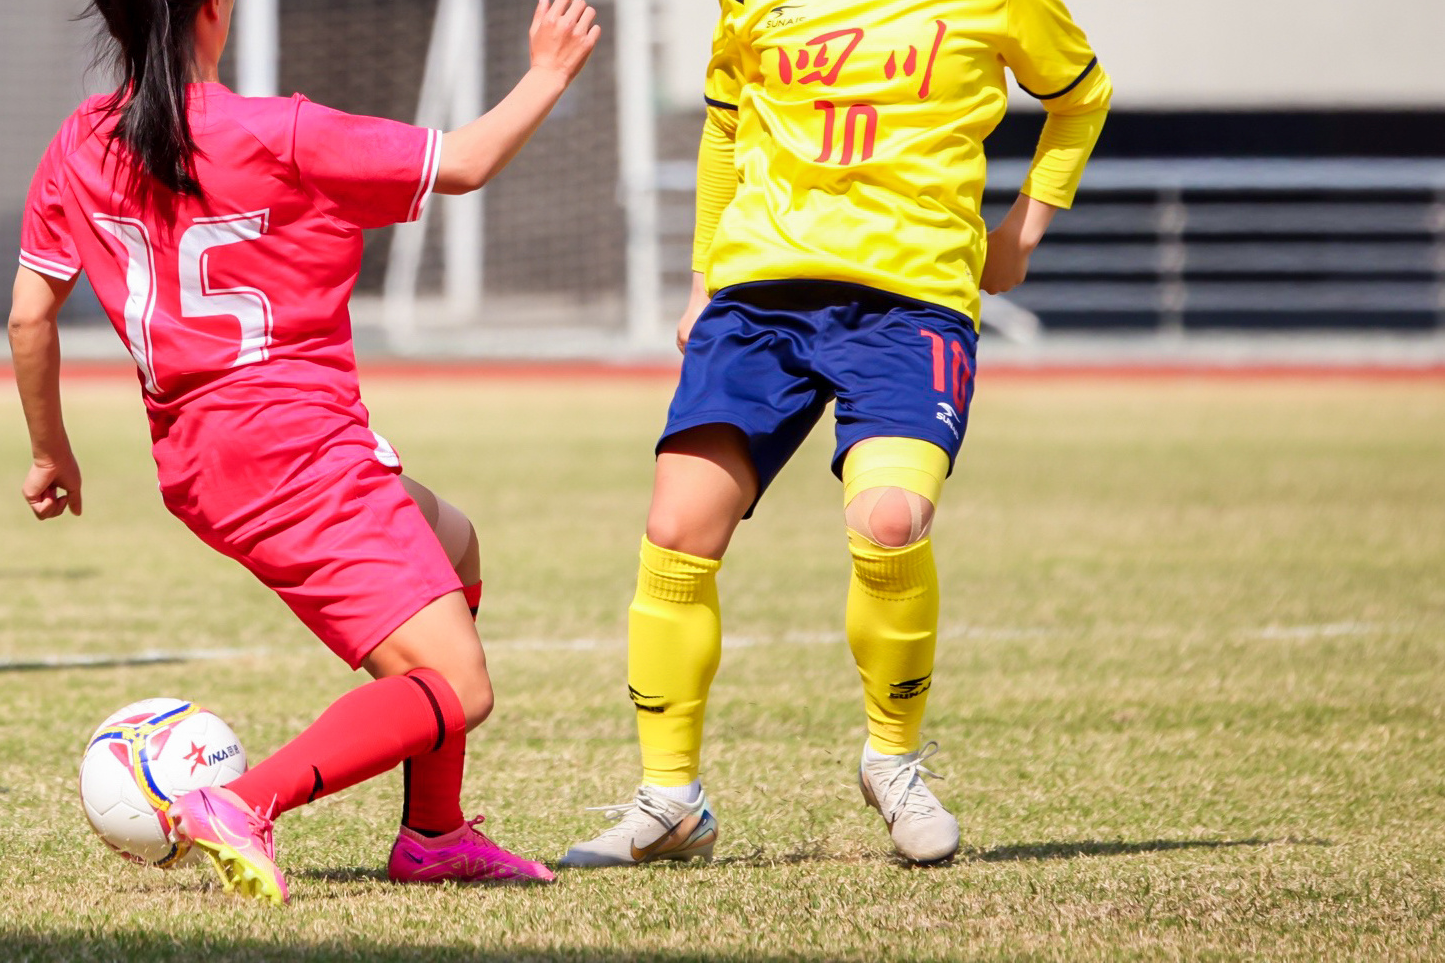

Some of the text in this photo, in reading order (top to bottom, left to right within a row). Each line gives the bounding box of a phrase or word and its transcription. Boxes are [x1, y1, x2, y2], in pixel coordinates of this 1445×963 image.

[778, 20, 946, 99] 四川
[813, 100, 878, 166] 10
[92, 207, 274, 395] 15
[919, 329, 971, 414] 10
